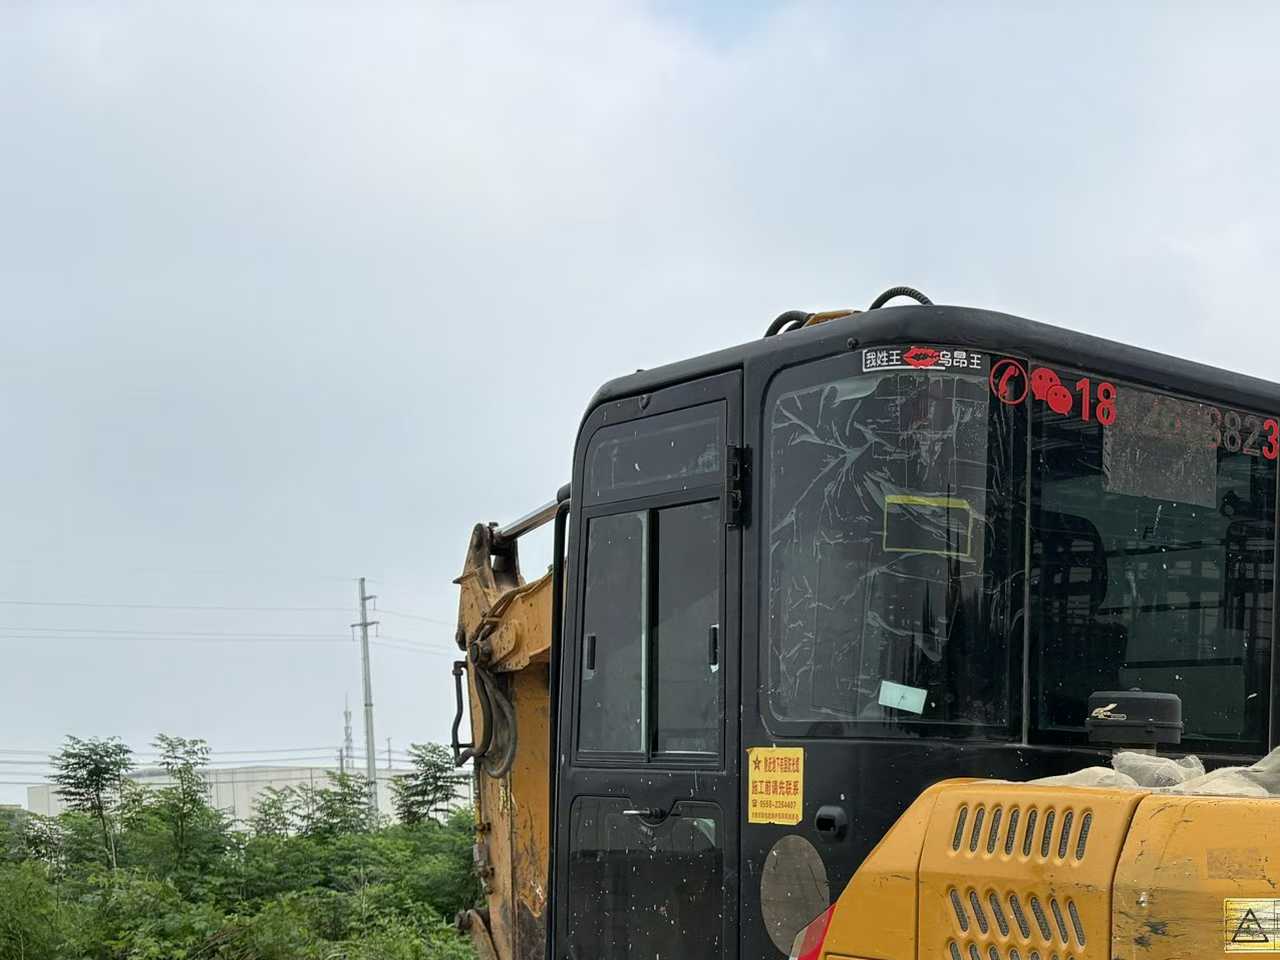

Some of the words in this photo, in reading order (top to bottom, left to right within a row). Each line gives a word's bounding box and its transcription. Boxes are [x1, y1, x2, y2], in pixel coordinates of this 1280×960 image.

[752, 780, 799, 796] 施工前请先联系
